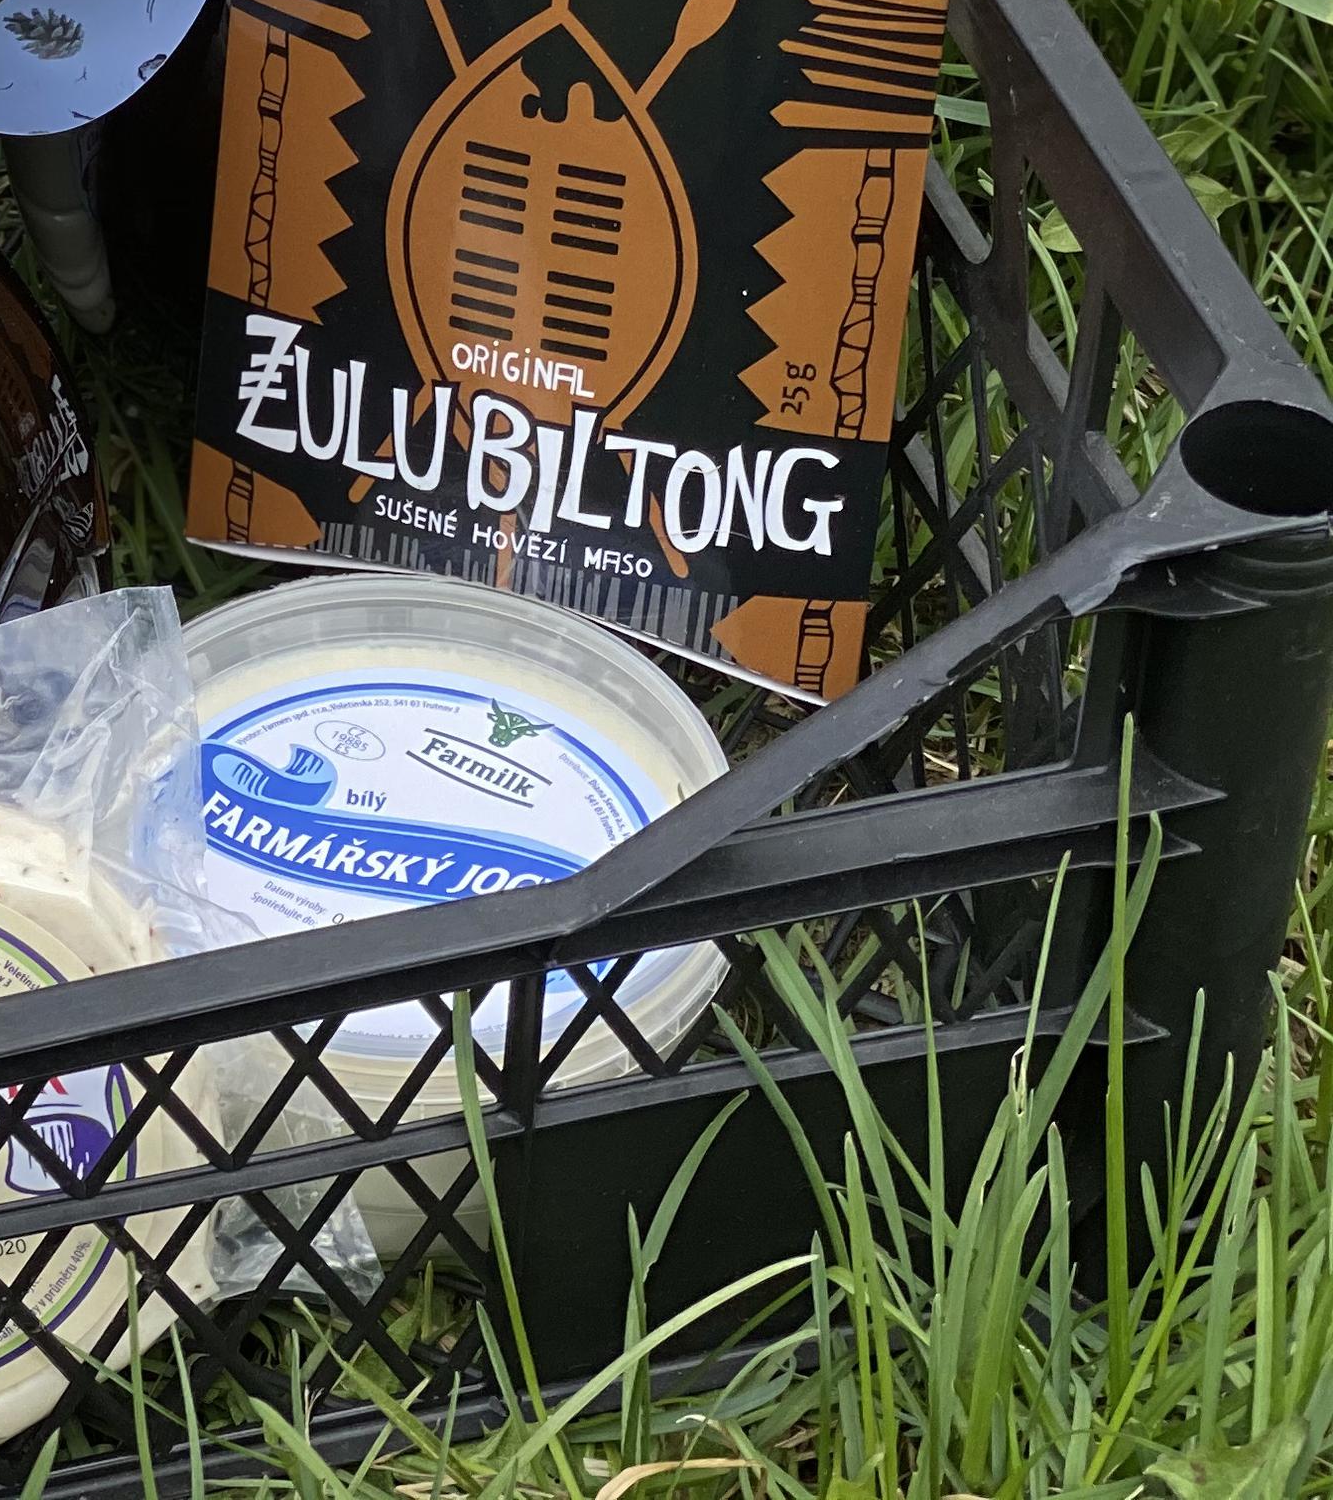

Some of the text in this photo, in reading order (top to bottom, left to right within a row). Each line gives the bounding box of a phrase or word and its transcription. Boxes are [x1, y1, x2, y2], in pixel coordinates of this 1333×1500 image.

[236, 313, 454, 492] ZULU
[466, 394, 845, 557] BILTONG
[374, 493, 459, 539] SUŠENÉ
[583, 548, 654, 579] MASO
[420, 737, 535, 798] Farmilk
[346, 789, 388, 812] bílý
[202, 790, 553, 896] FARMÁŘSKÝ JOG
[250, 891, 304, 921] Spotřebujte
[263, 880, 327, 915] Datum výroby:
